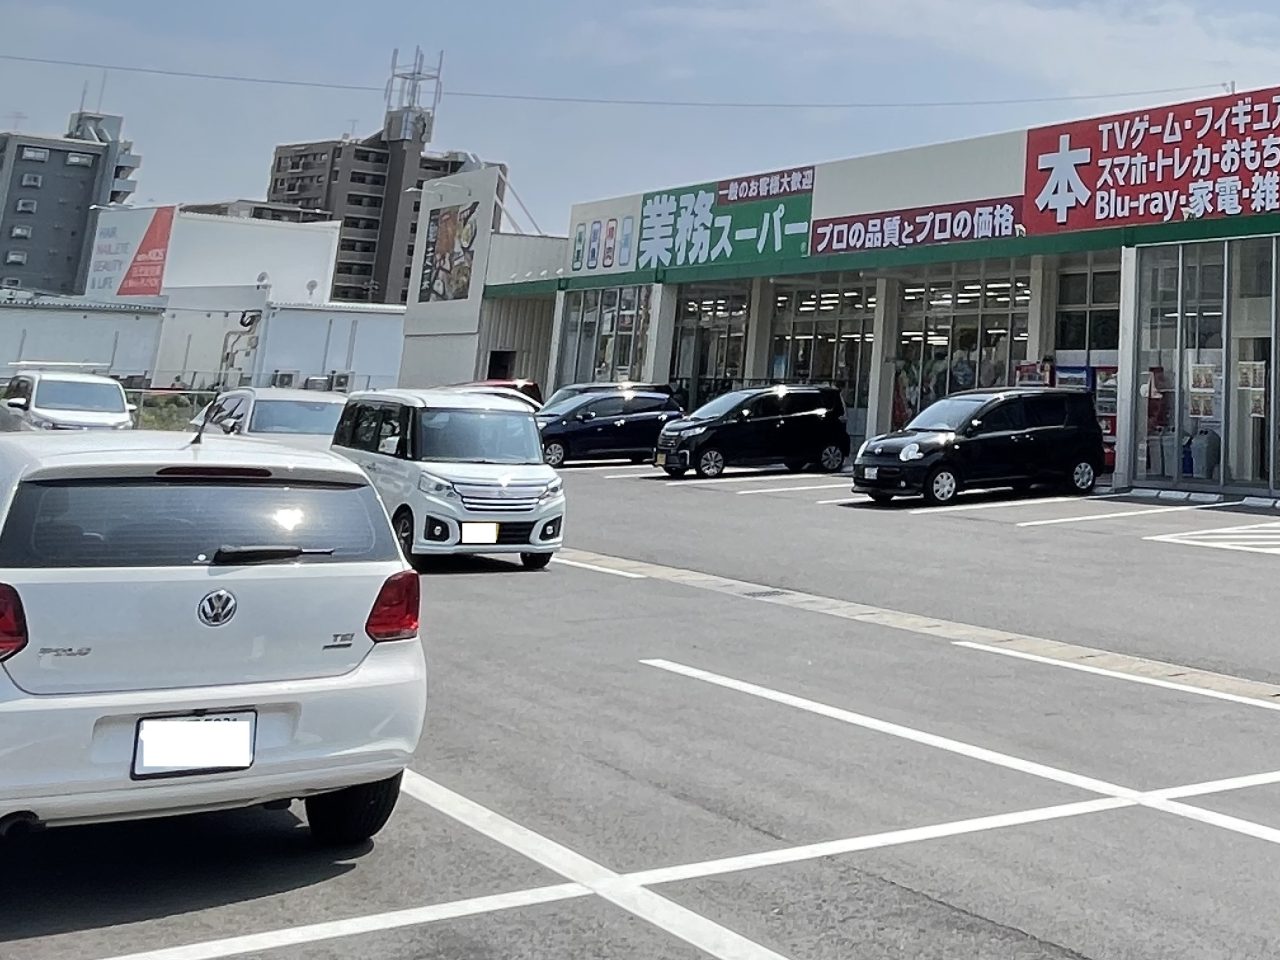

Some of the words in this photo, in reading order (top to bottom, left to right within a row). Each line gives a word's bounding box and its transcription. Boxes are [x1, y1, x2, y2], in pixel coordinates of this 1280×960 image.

[718, 169, 813, 201] 一般のお客様大歓迎
[1035, 134, 1092, 224] 本
[638, 190, 808, 269] 業務スーパー
[816, 203, 1015, 253] プロの品質とプロの価格
